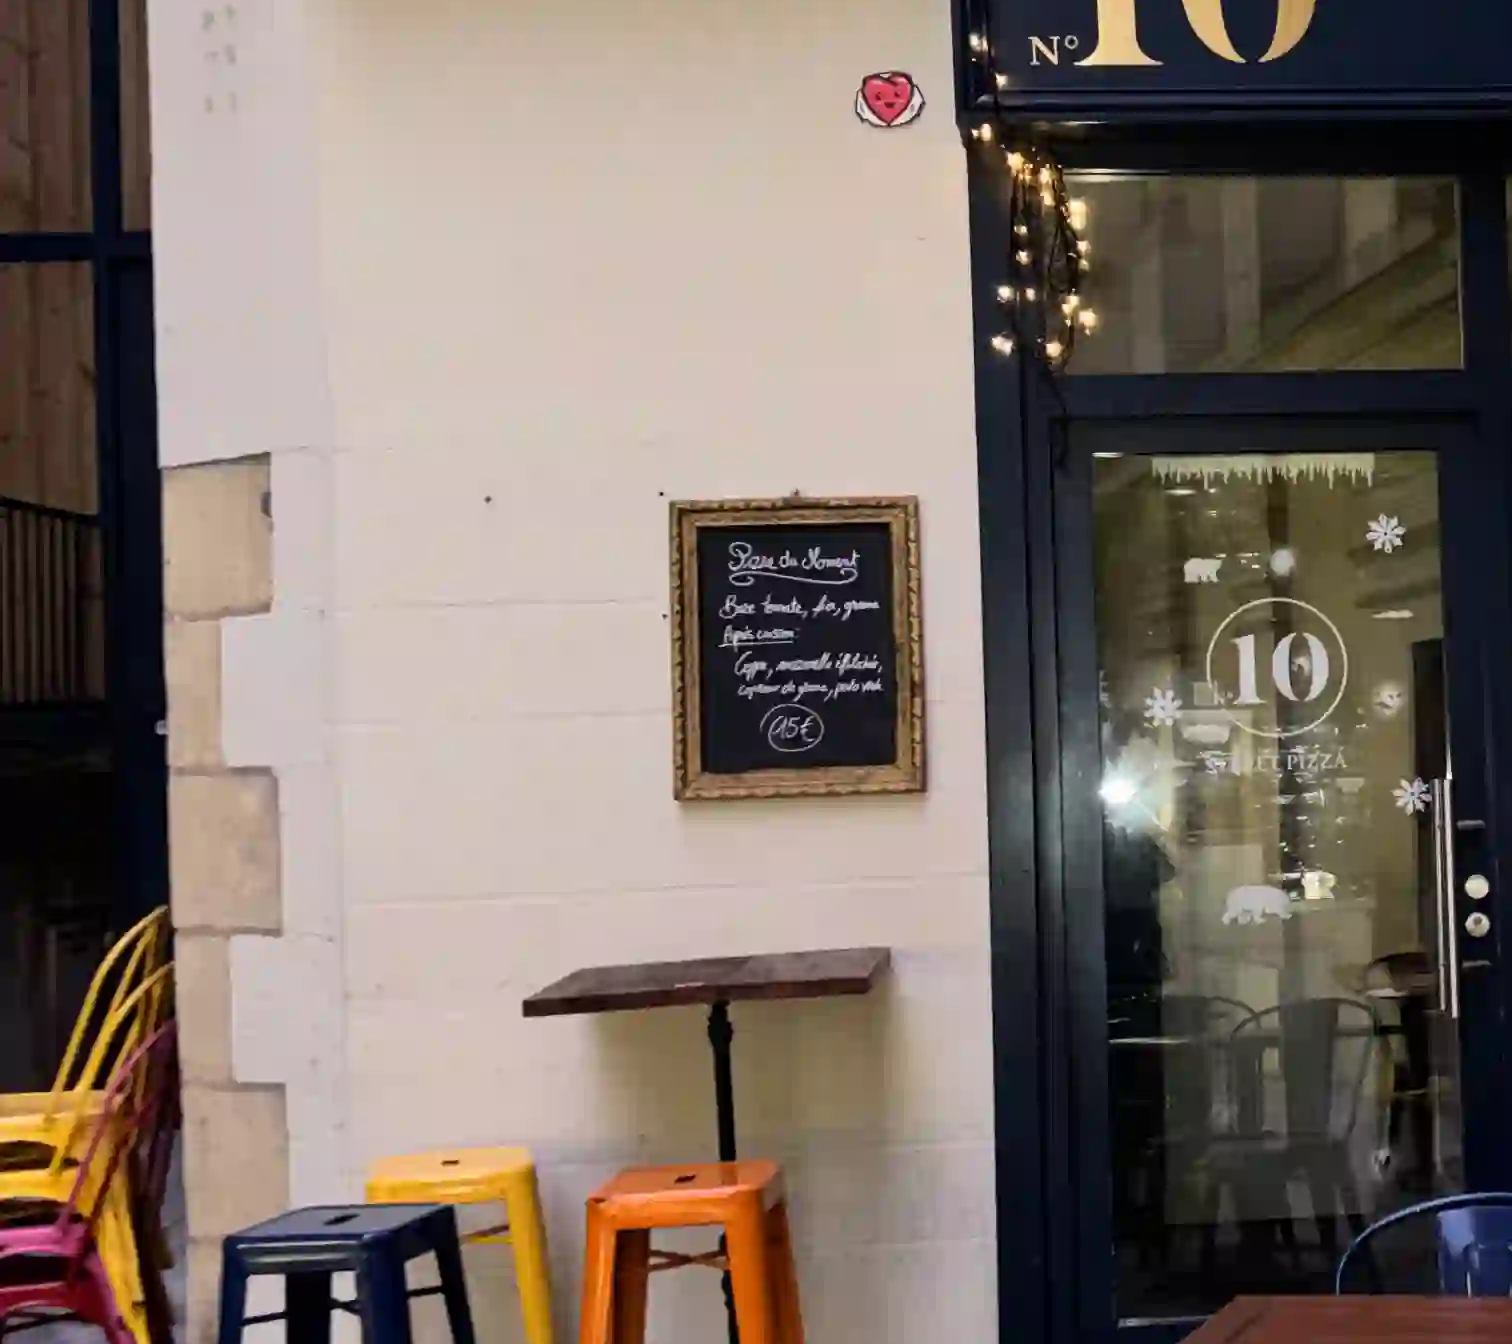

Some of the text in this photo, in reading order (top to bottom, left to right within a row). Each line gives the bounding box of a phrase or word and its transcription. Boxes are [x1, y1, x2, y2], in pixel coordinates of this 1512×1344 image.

[779, 549, 799, 568] du
[1229, 631, 1330, 705] 10
[1286, 751, 1348, 770] PIZZA
